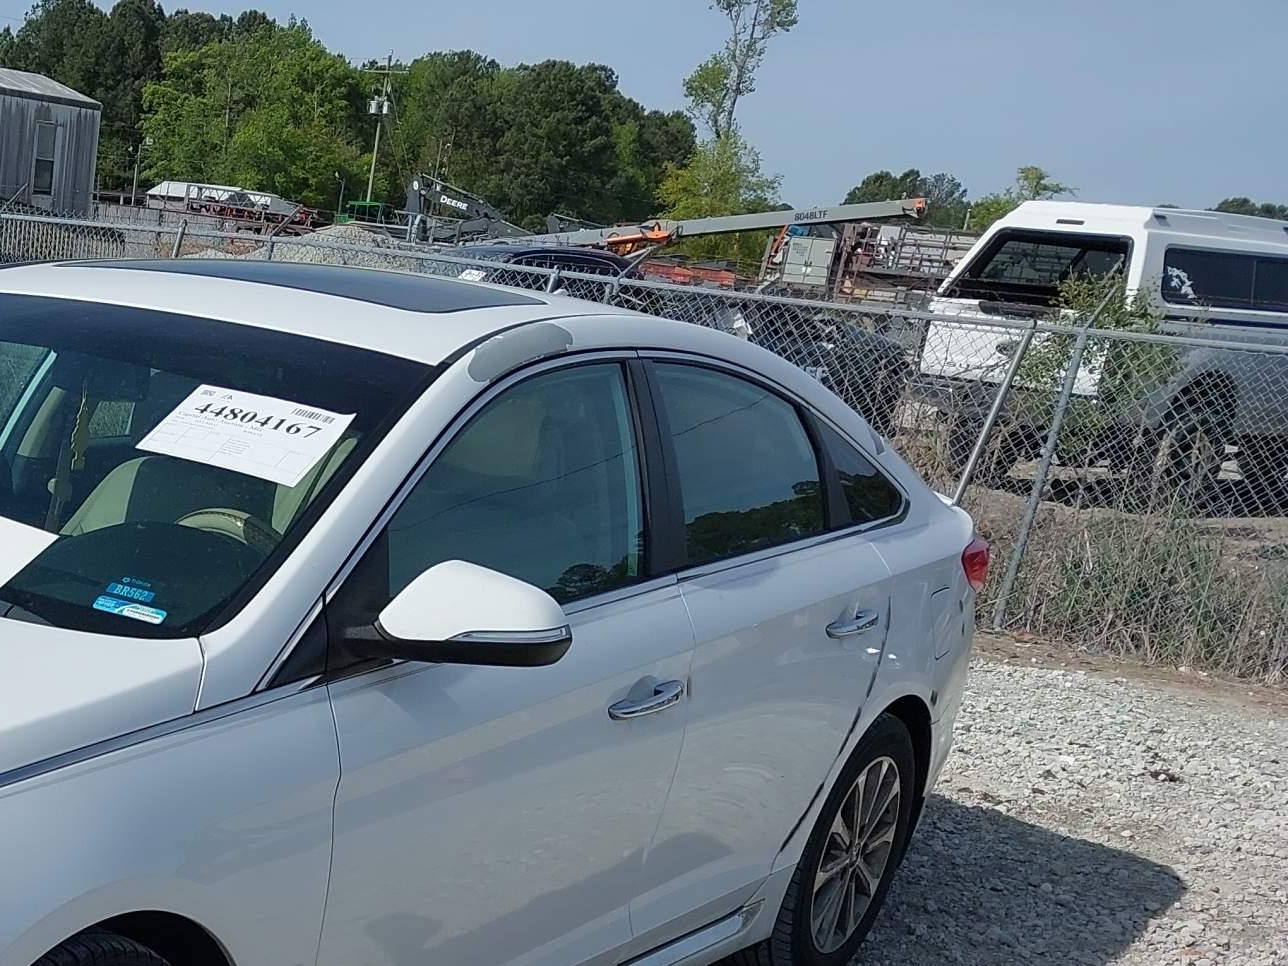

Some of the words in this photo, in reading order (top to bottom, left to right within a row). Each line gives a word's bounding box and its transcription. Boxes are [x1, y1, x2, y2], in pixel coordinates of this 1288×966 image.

[440, 195, 469, 210] DEERE
[794, 210, 829, 222] 8048LTF
[195, 403, 323, 439] 44804167
